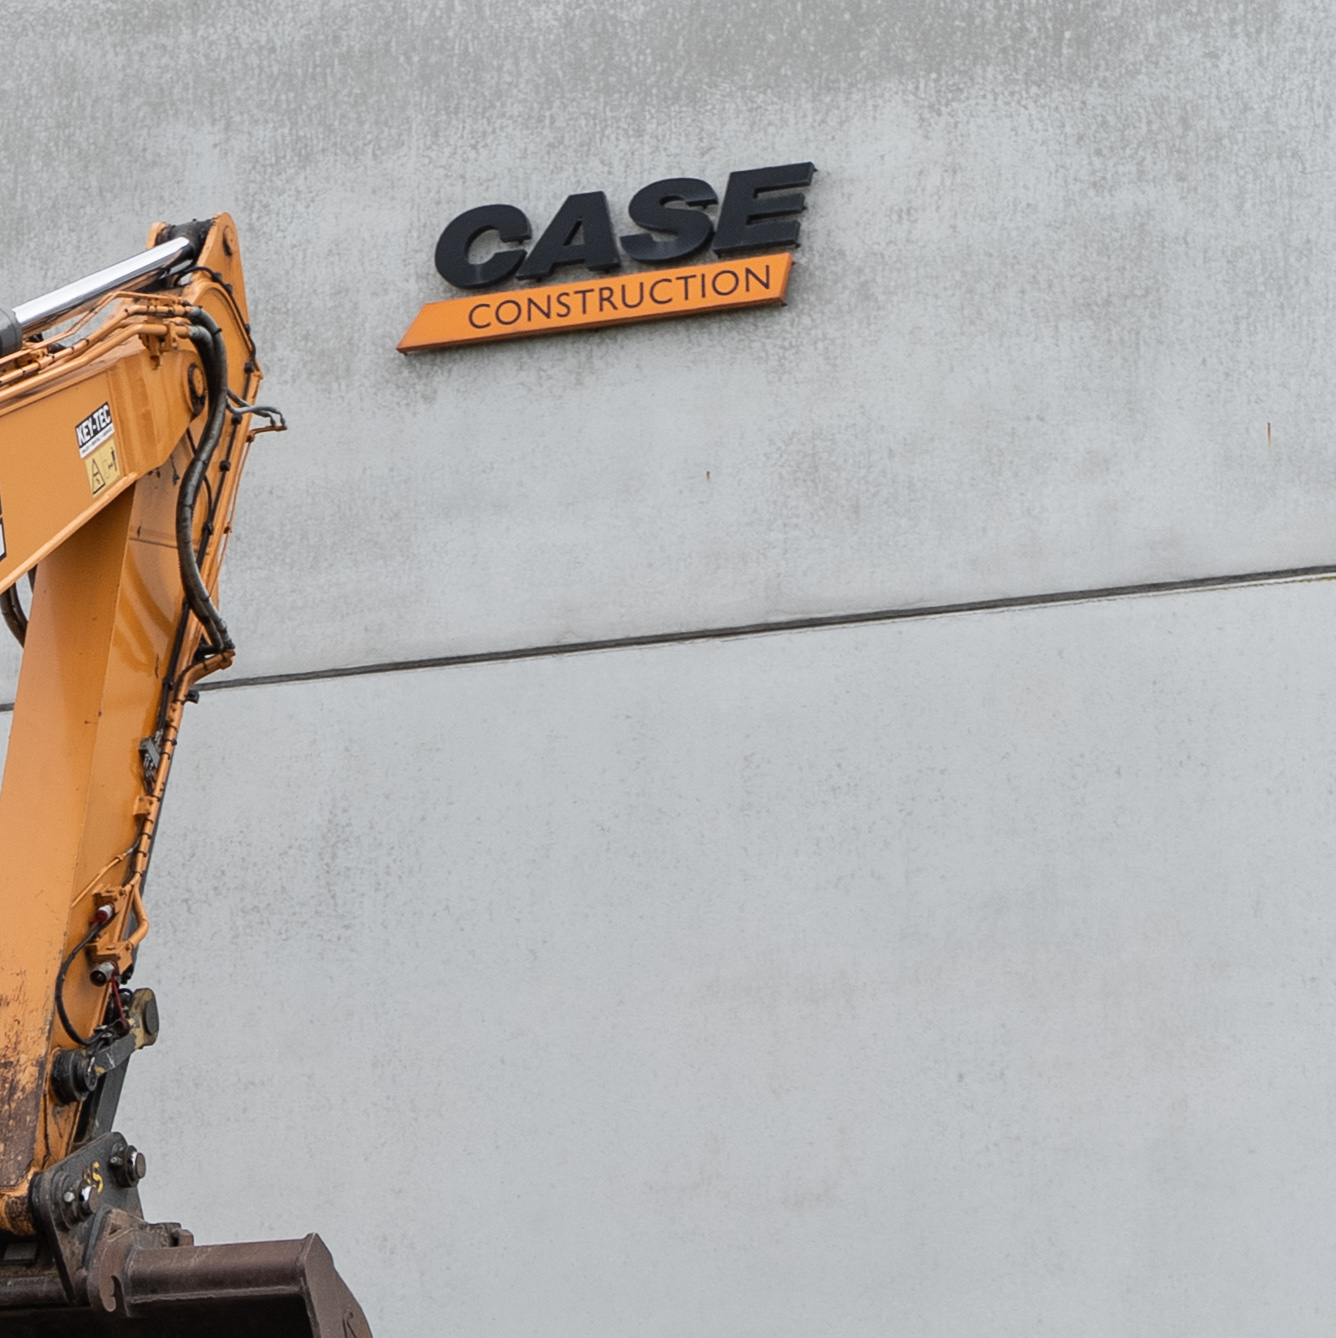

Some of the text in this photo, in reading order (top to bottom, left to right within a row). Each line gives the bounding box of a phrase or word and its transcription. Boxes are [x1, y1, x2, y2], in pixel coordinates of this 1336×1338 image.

[434, 161, 818, 291] CASE
[468, 264, 771, 330] CONSTRUCTION
[76, 404, 111, 446] KEY-TEC
